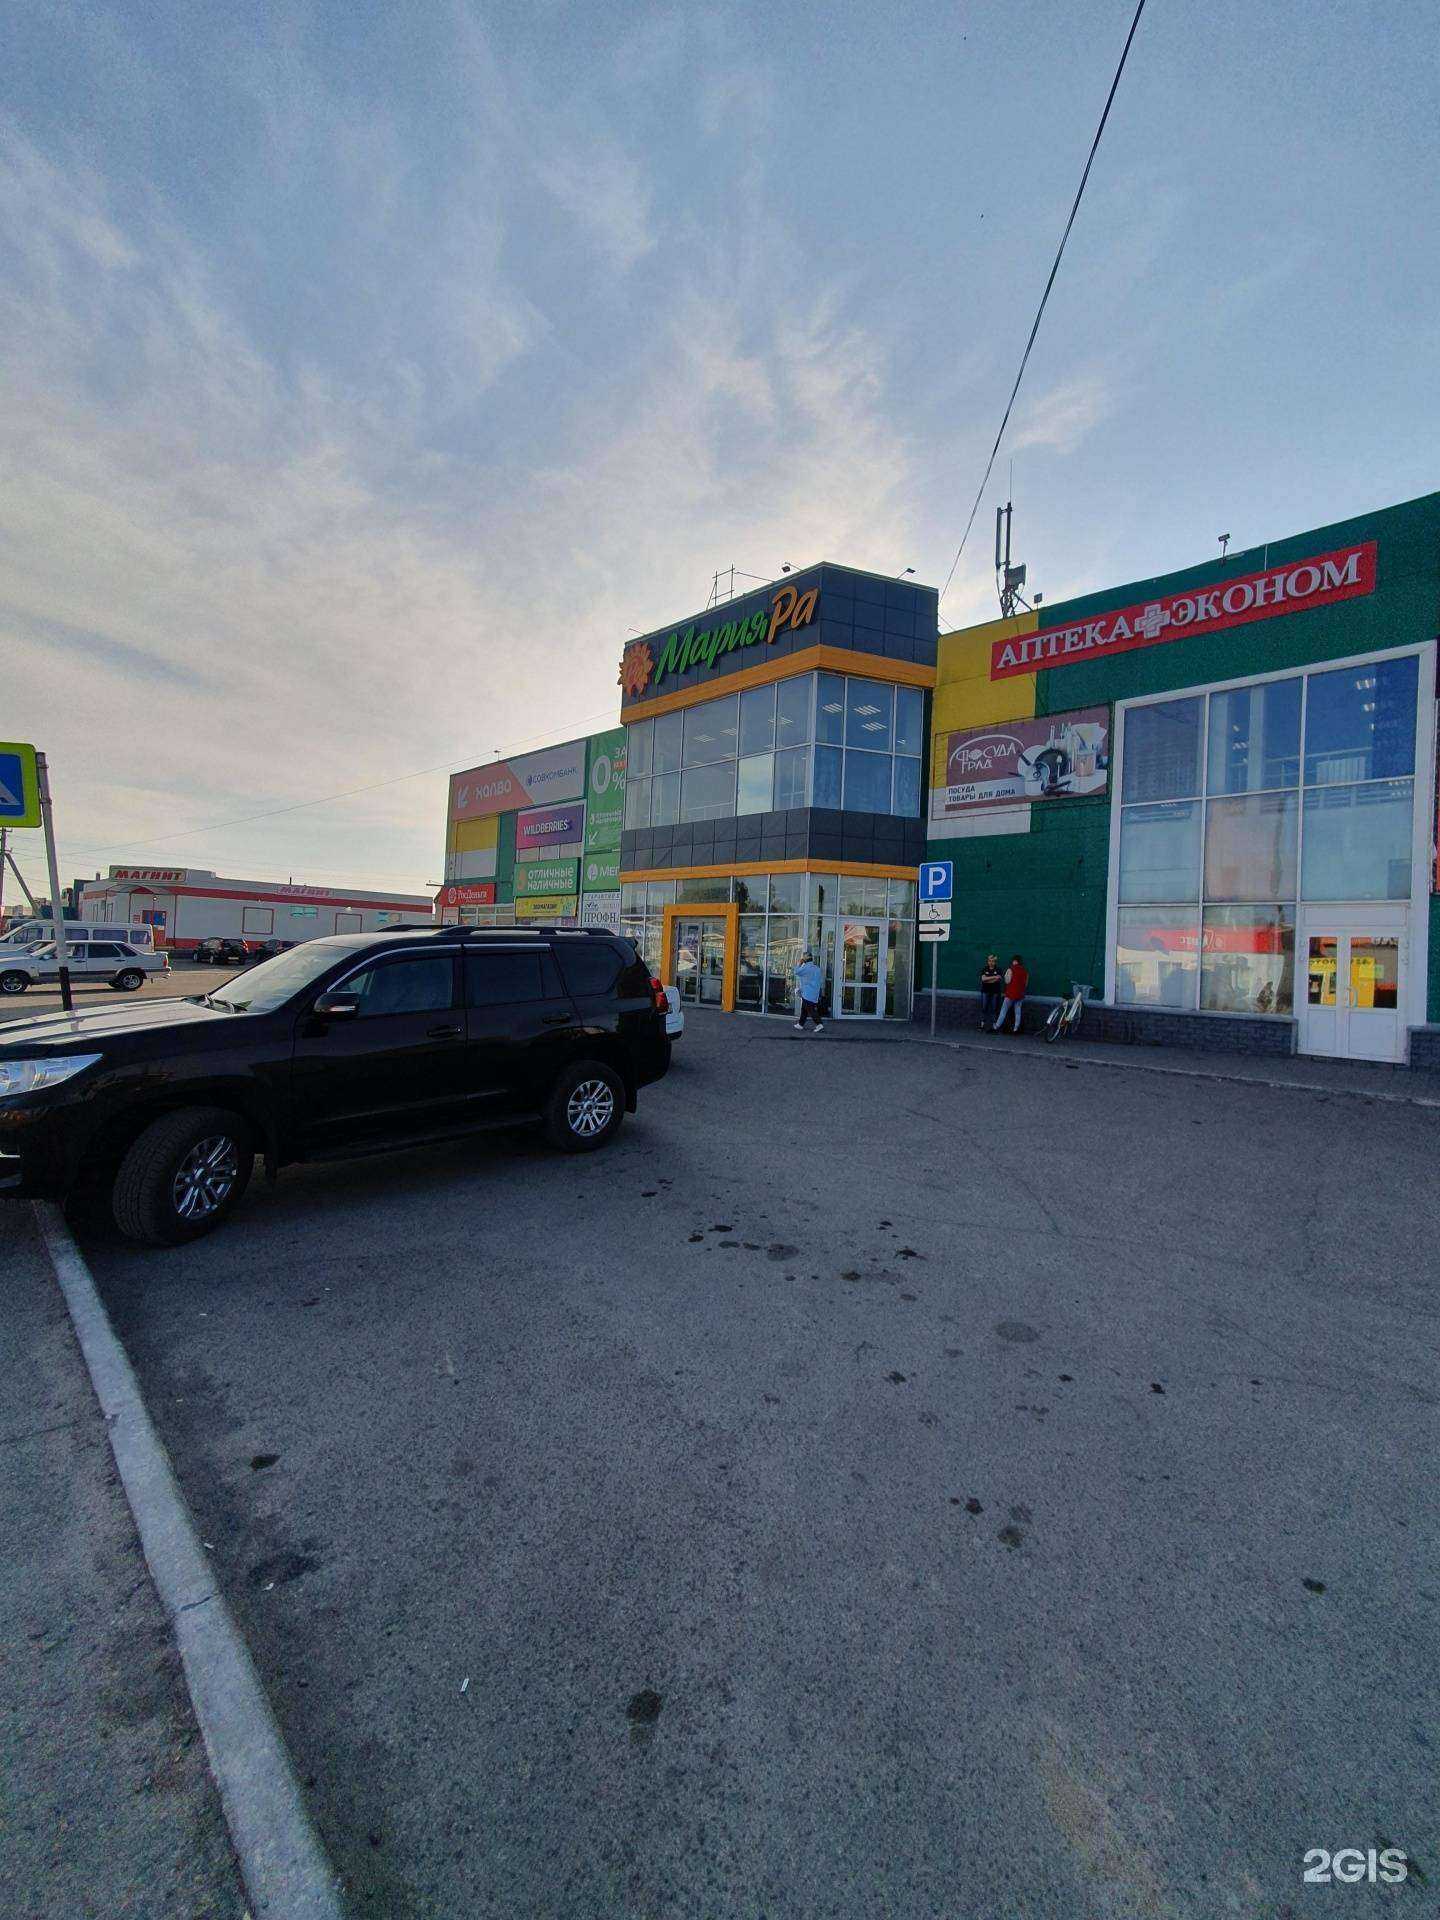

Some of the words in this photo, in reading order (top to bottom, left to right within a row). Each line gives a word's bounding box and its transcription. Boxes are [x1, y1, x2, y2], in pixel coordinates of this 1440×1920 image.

[997, 614, 1134, 669] АПТЕКА
[1169, 553, 1362, 626] ЭКОНОМ
[948, 785, 976, 795] ПОСУДА
[949, 793, 976, 803] ТОВАРЫ
[978, 790, 993, 800] ДЛЯ
[995, 788, 1016, 798] ДОМА
[523, 819, 568, 836] WILDBERRIES
[115, 870, 182, 881] МАГНИТ
[928, 867, 947, 896] P
